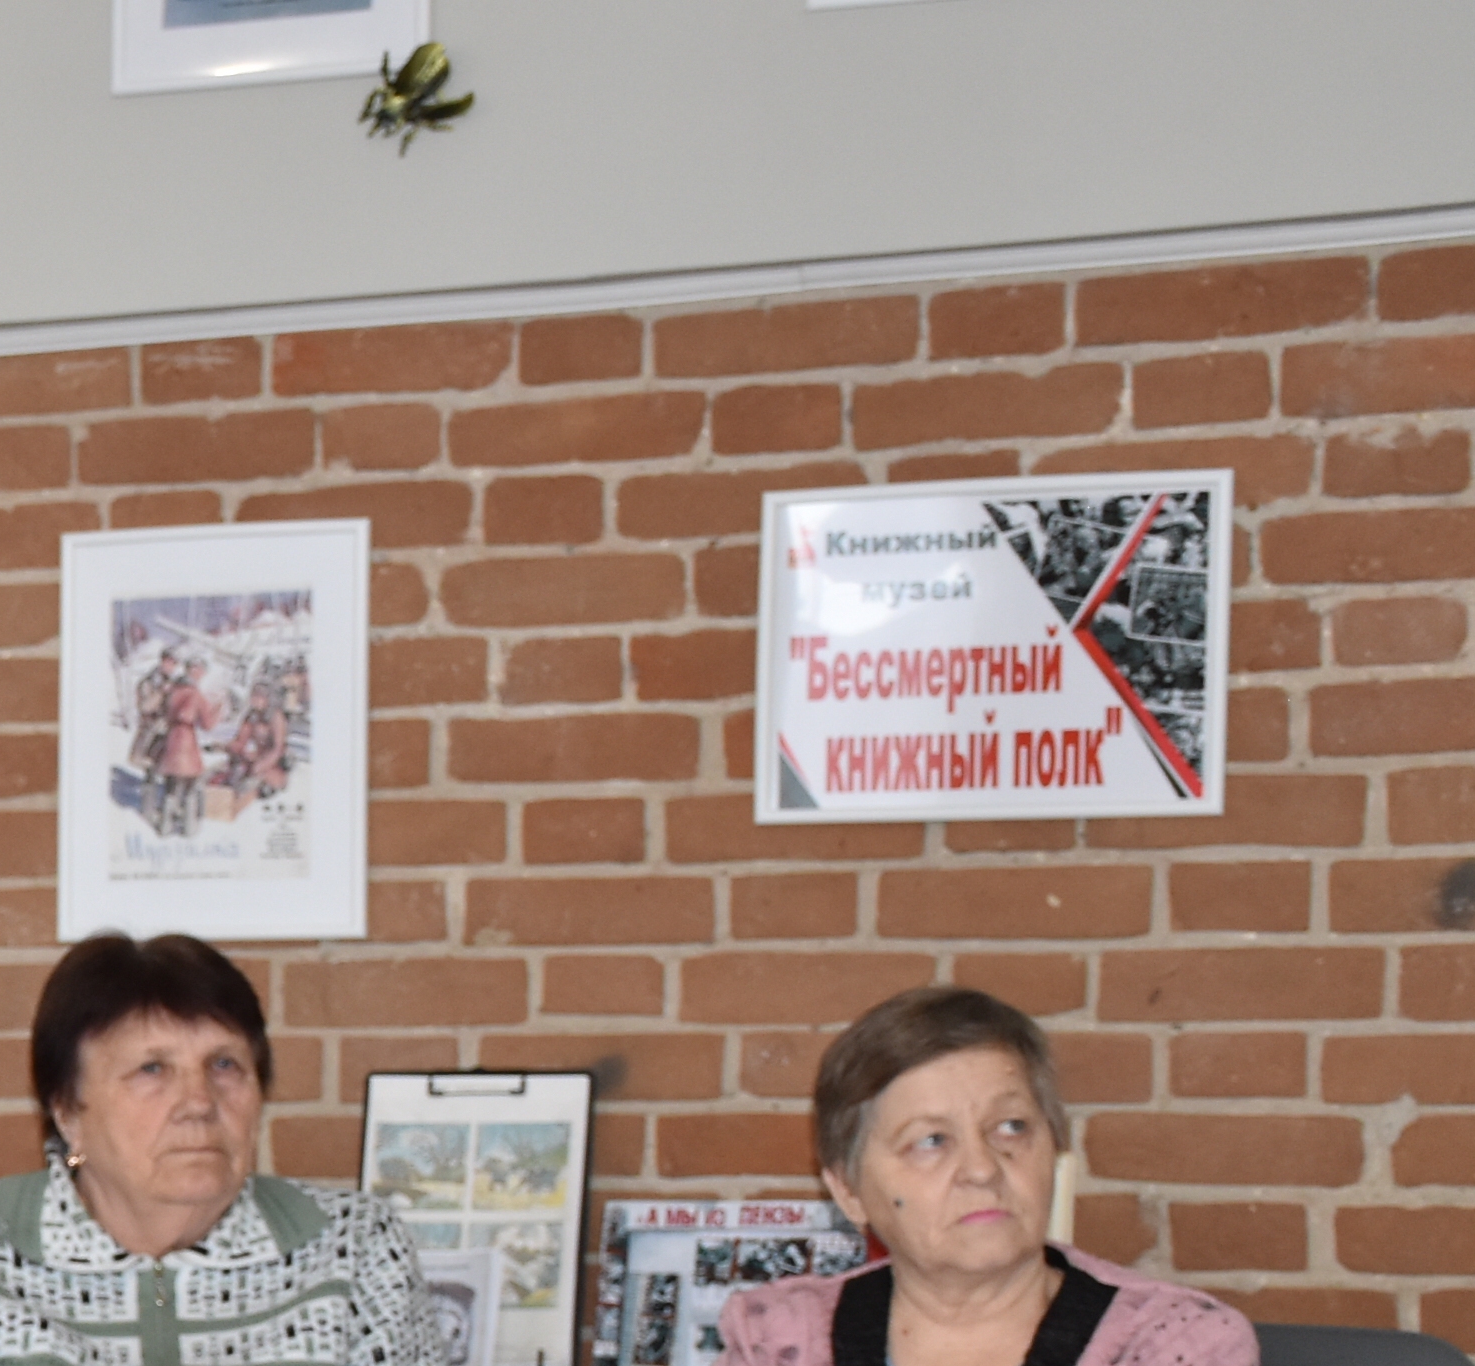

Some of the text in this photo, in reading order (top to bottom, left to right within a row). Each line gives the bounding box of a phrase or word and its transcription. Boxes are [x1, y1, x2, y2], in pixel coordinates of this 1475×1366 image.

[825, 522, 998, 557] Книжный
[862, 571, 973, 608] музей
[789, 625, 1064, 712] "Бессмертный
[825, 706, 1122, 793] книжный полк"
